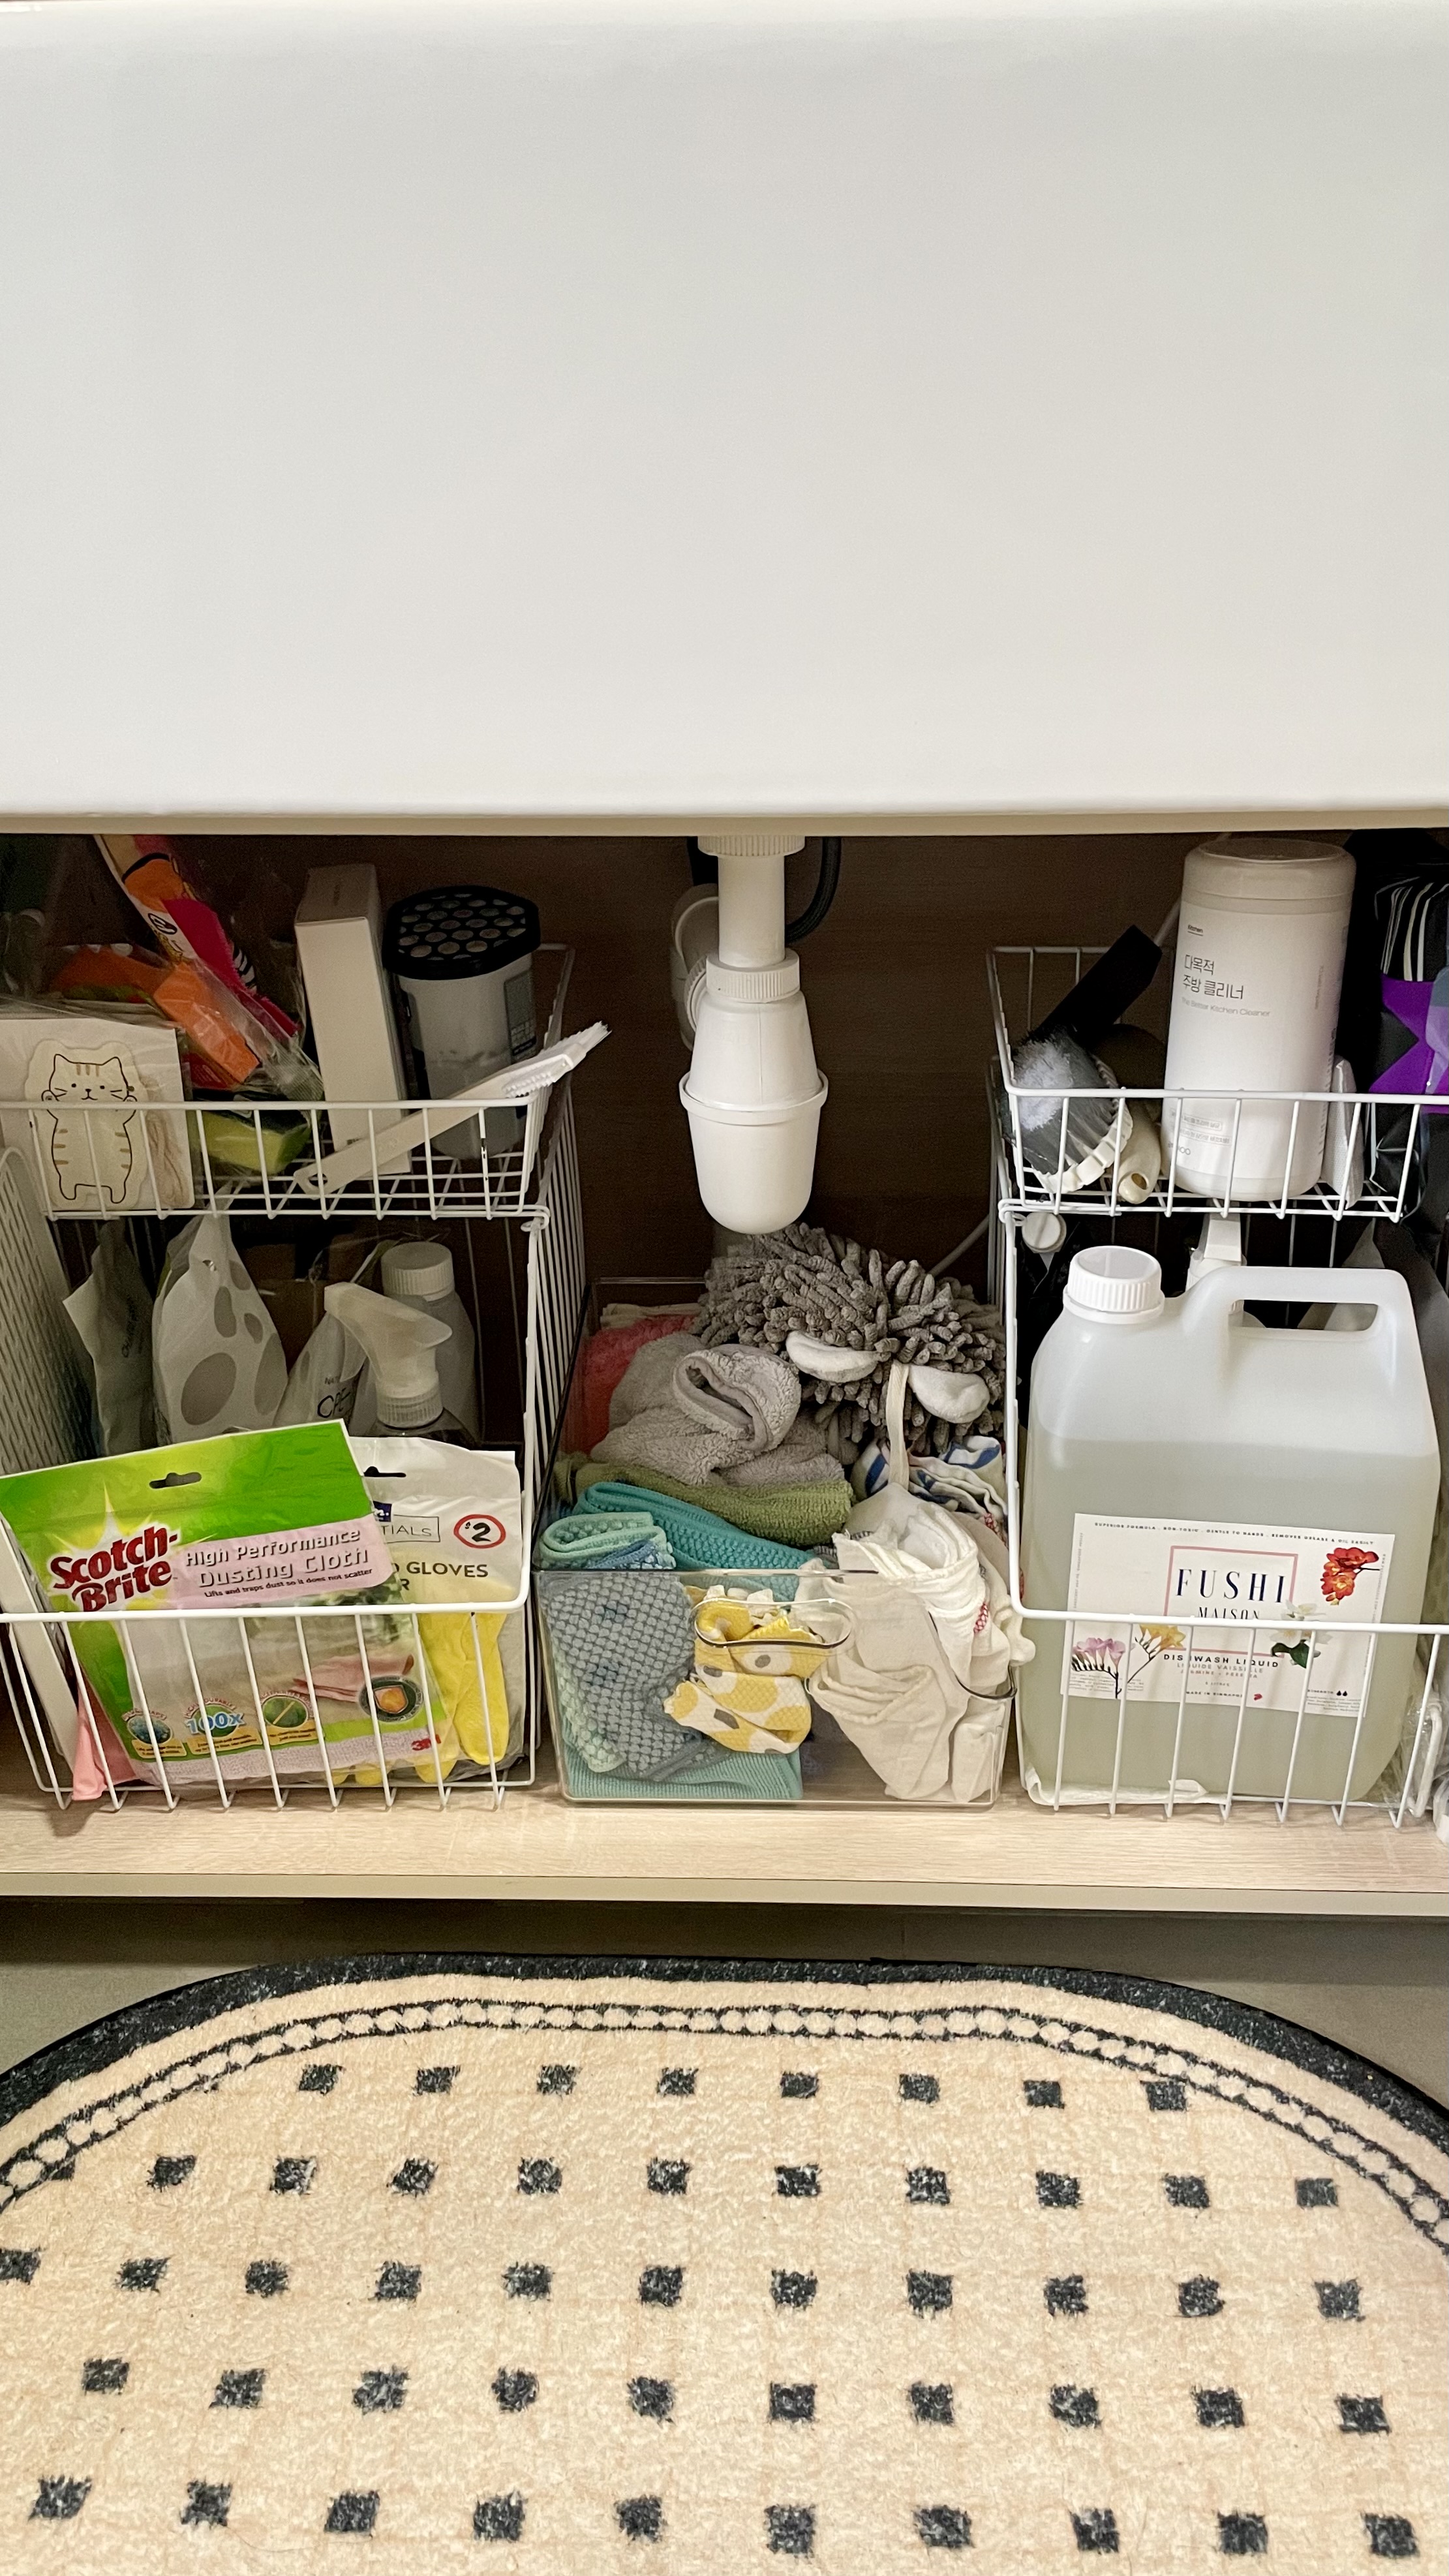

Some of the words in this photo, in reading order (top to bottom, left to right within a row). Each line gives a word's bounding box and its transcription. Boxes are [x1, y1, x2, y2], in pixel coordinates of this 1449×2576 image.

[1184, 954, 1215, 975] 다목적
[1182, 974, 1202, 993] 주방
[1204, 980, 1244, 1000] 클리너
[1240, 1008, 1271, 1017] Cleaner
[50, 1526, 178, 1589] Scotch-
[186, 1548, 229, 1567] High
[237, 1529, 361, 1561] Performance
[198, 1563, 294, 1587] Dusting
[304, 1548, 369, 1574] Cloth
[344, 1569, 373, 1579] scatter
[406, 1561, 489, 1578] GLOVES
[72, 1561, 172, 1612] Brite
[1176, 1569, 1286, 1603] FUSHI
